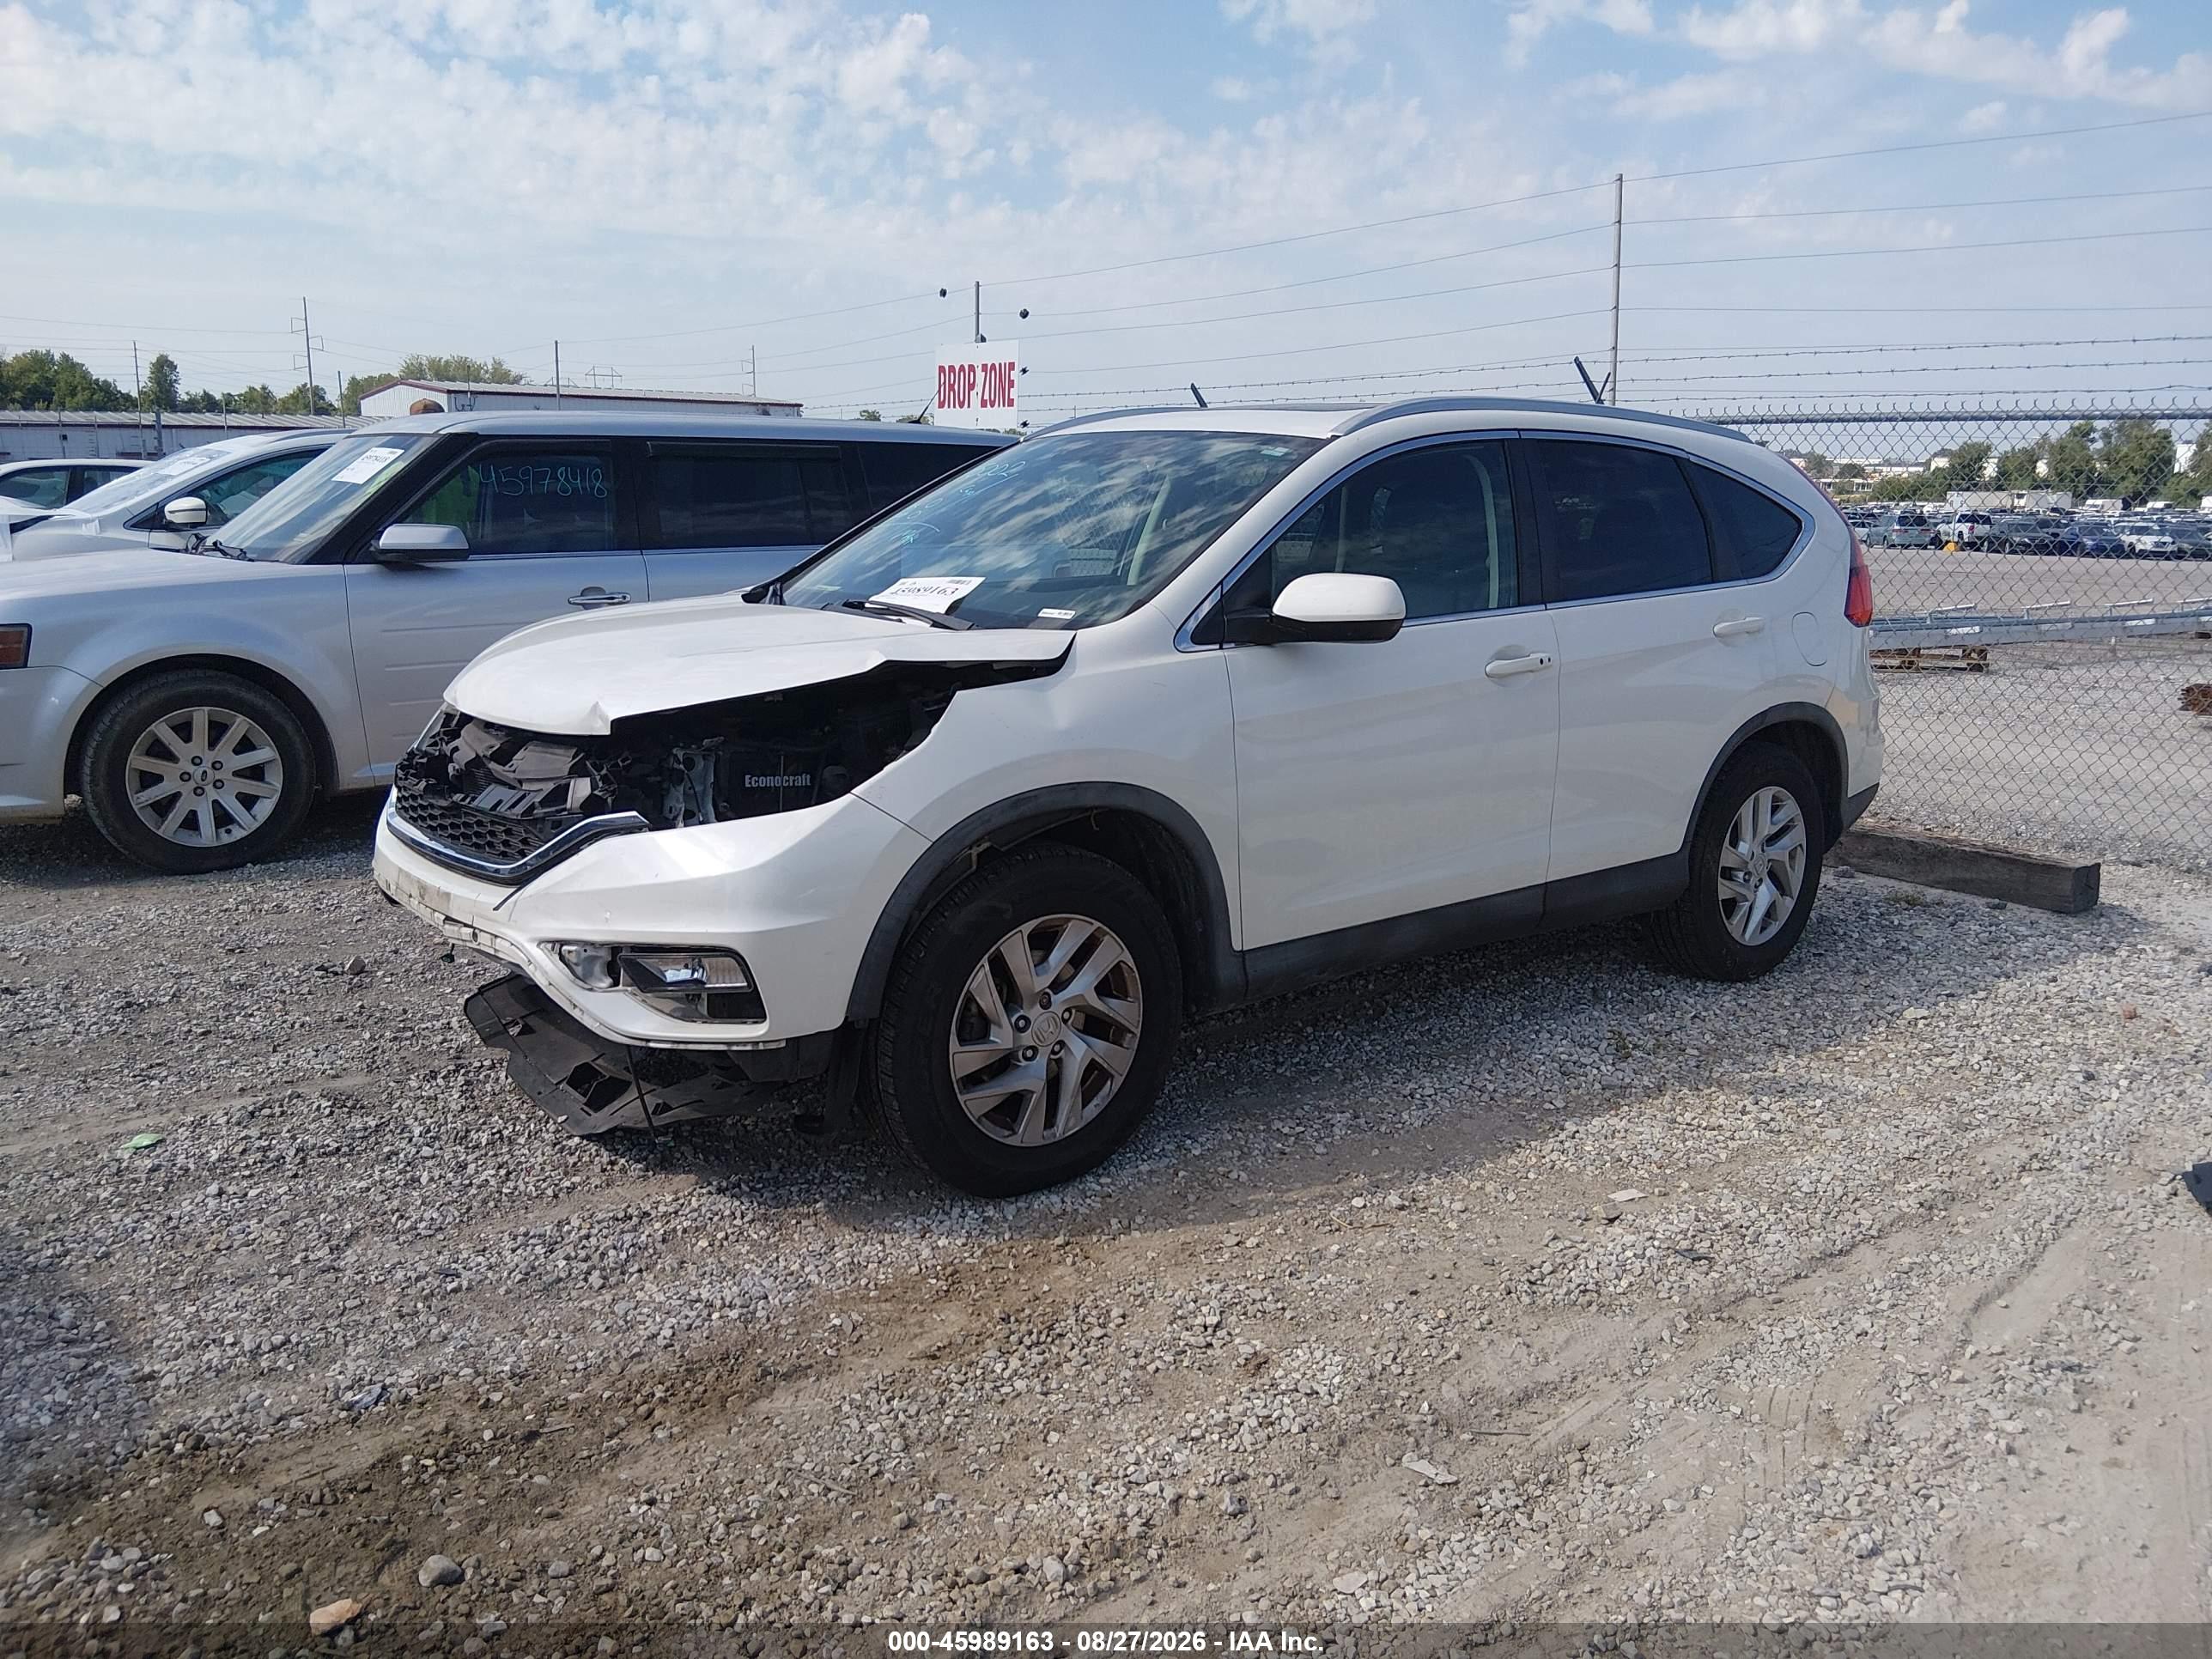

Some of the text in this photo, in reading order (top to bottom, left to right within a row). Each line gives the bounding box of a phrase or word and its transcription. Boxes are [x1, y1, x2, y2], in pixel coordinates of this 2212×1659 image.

[937, 361, 1016, 410] DROP ZONE
[479, 464, 608, 498] 45978418
[744, 773, 811, 787] Econocraft
